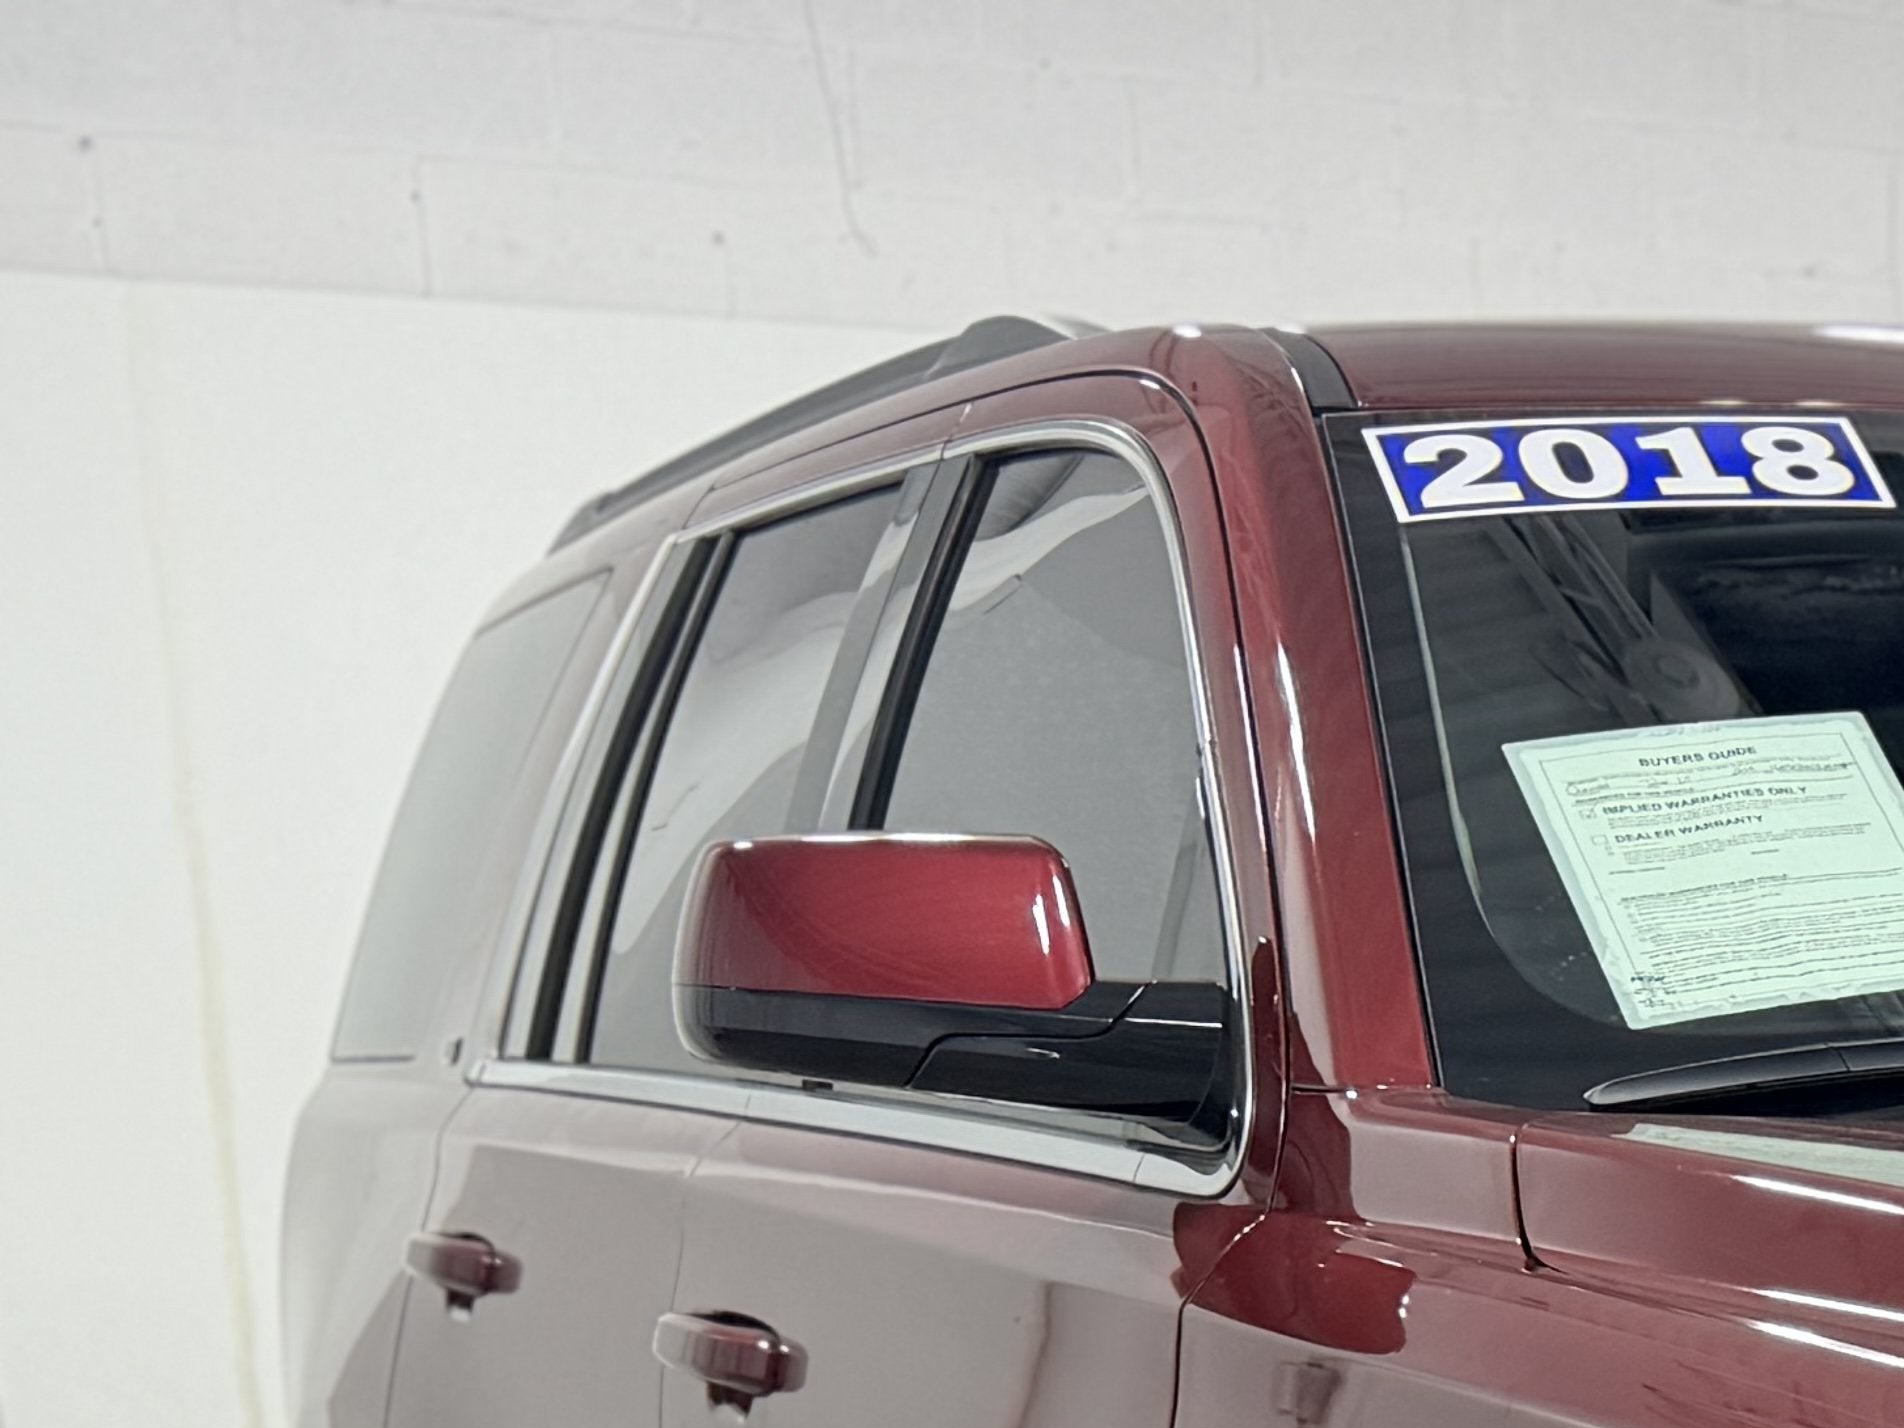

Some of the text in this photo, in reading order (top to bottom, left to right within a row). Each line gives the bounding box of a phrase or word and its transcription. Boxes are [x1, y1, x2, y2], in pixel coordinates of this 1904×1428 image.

[1402, 426, 1856, 509] 2018
[1638, 745, 1758, 768] BUYERS GUIDE
[1602, 799, 1661, 816] IMPLIED
[1664, 787, 1765, 810] WARRANTIES
[1768, 784, 1809, 798] ONLY
[1614, 829, 1675, 845] DEALER
[1678, 814, 1764, 837] WARRANTY
